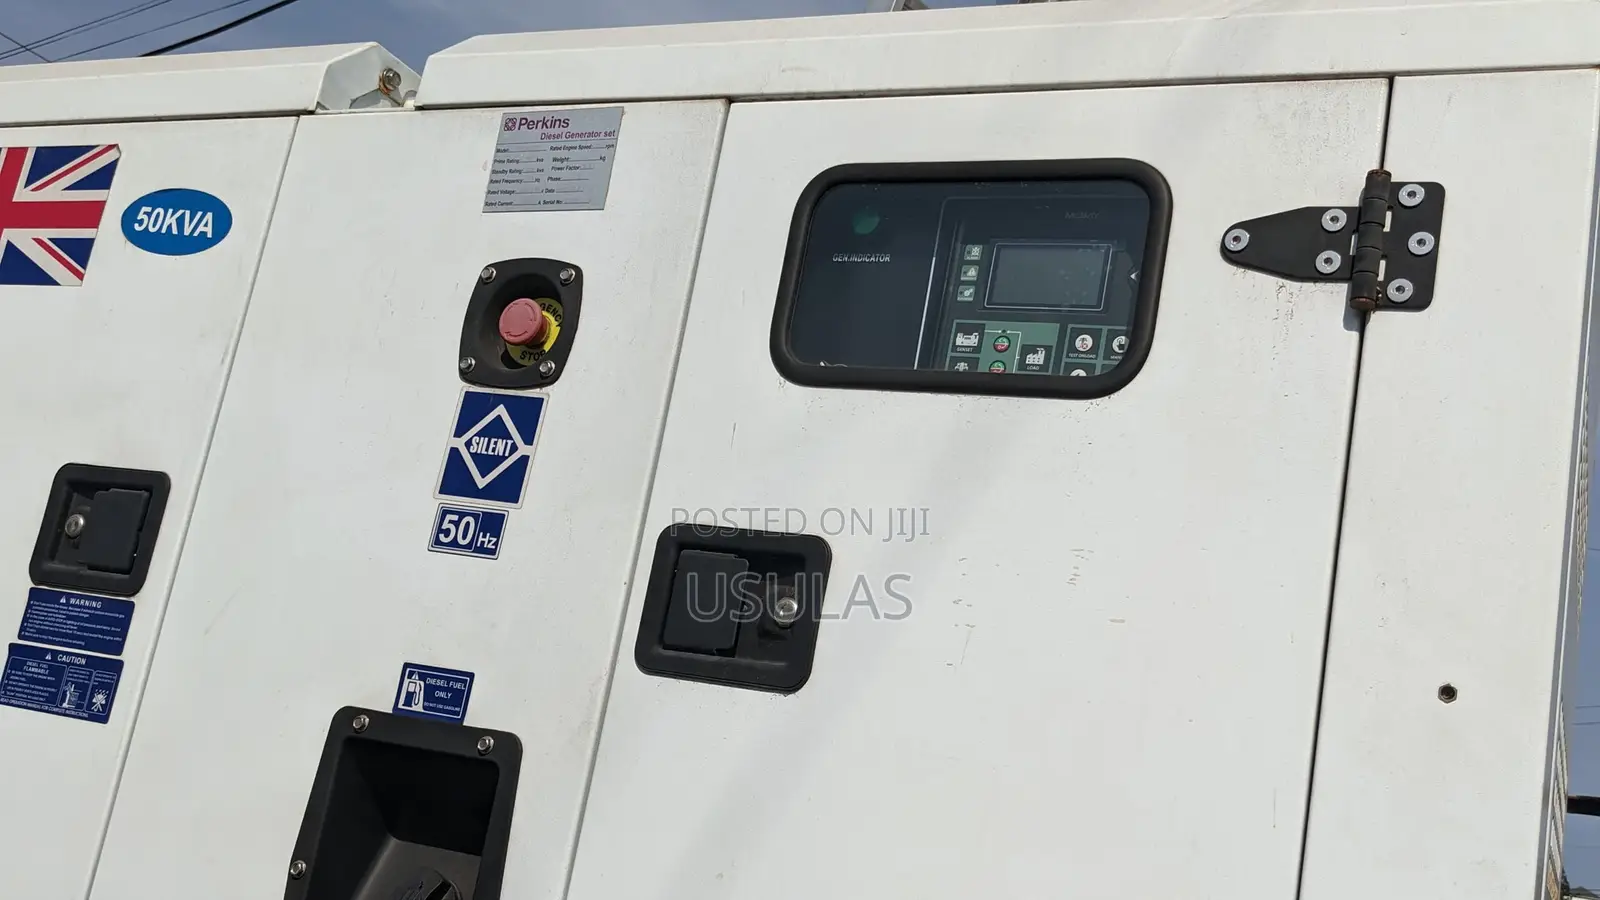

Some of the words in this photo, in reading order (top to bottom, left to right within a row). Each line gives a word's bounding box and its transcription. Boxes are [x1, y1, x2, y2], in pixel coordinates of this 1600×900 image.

[518, 116, 570, 130] Perkins
[540, 132, 563, 140] Diesel
[564, 130, 602, 139] Generator
[134, 206, 213, 238] 50KVA
[832, 253, 891, 262] GEN.INDICATOR
[470, 436, 514, 456] SILENT
[438, 514, 475, 546] 50
[477, 532, 497, 549] Hz
[69, 598, 102, 609] WARNING
[57, 654, 87, 665] CAUTION
[426, 677, 448, 687] DIESEL
[449, 681, 466, 690] FUEL
[434, 690, 453, 699] ONLY
